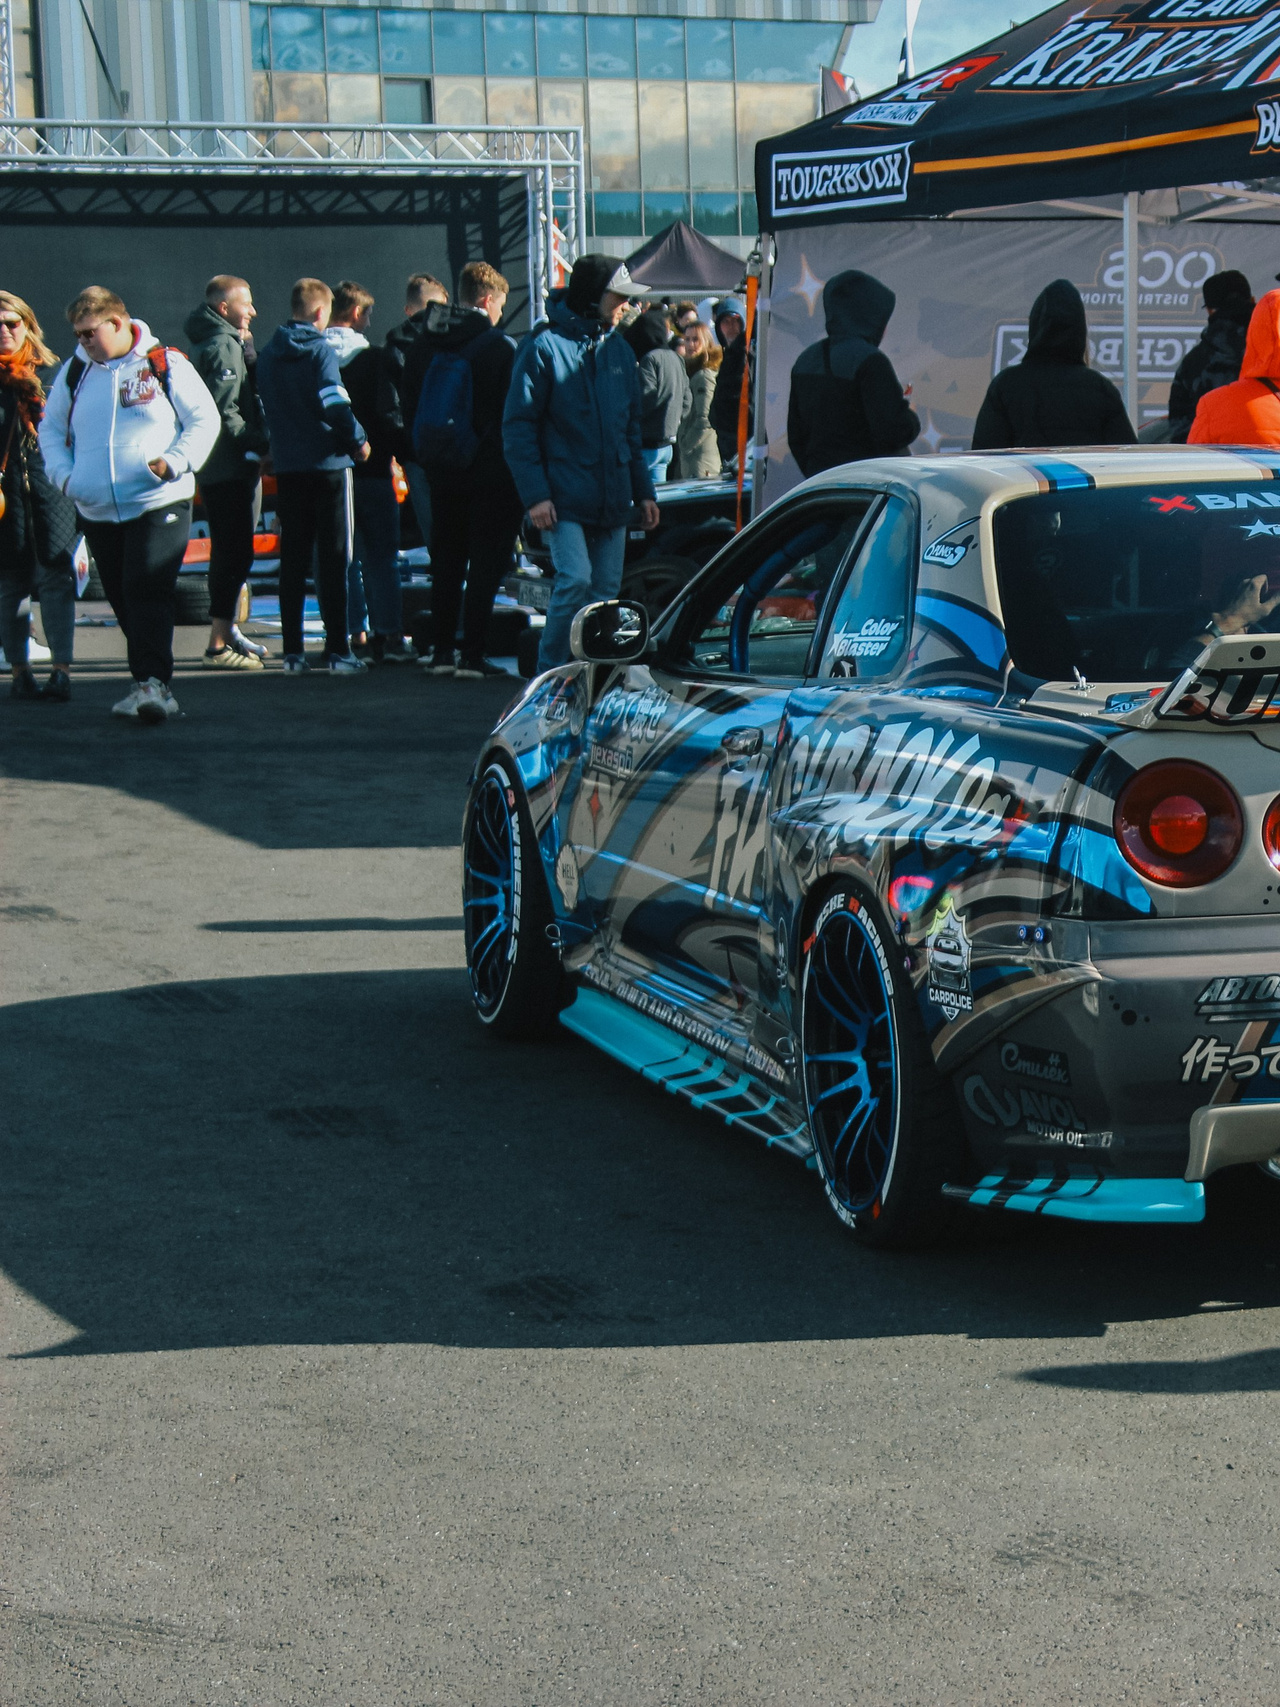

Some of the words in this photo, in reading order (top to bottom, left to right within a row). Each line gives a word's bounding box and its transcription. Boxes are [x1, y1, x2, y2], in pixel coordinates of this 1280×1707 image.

[1149, 0, 1268, 18] TEAM
[778, 153, 903, 202] TOUGHBOOK
[861, 618, 900, 636] Color
[837, 638, 888, 658] Blaster
[508, 811, 522, 965] WHEELS
[848, 896, 894, 996] RACING
[929, 987, 973, 1010] CARPOLICE
[1026, 1119, 1064, 1142] MOTOR
[1066, 1131, 1084, 1147] OIL
